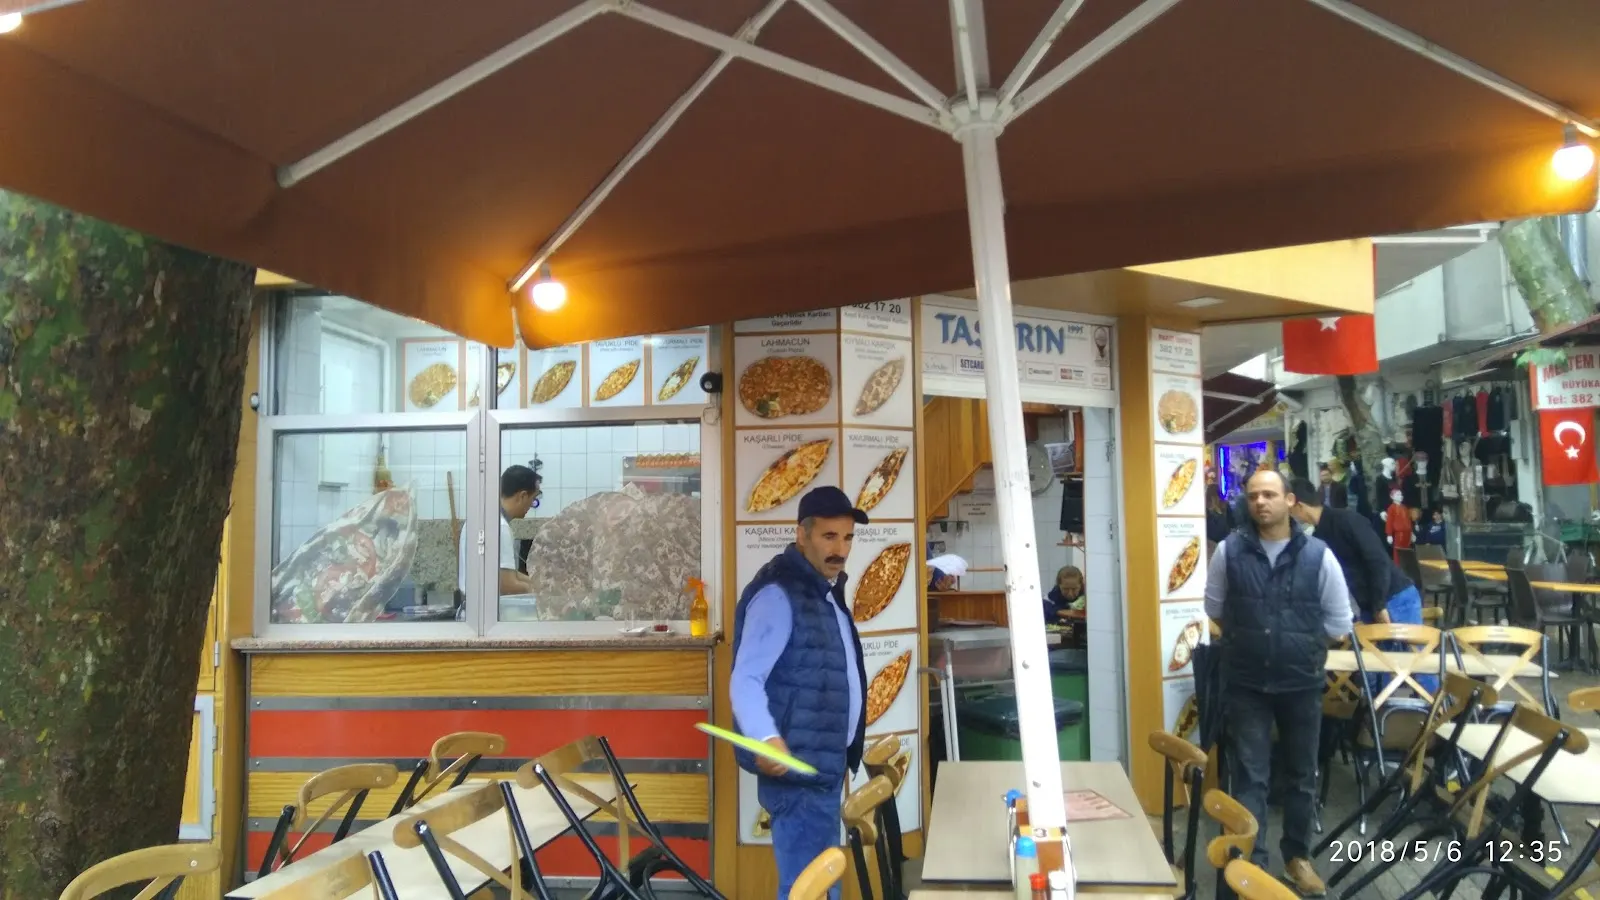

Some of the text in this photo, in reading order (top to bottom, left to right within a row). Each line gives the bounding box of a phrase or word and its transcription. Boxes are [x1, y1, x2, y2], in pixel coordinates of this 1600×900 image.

[875, 301, 886, 312] 17
[889, 303, 901, 313] 20
[761, 338, 810, 347] LAHMACUN
[1546, 393, 1594, 404] Tel: 382
[744, 434, 781, 444] KAŞARLI
[745, 527, 796, 537] KAŞARLI KA
